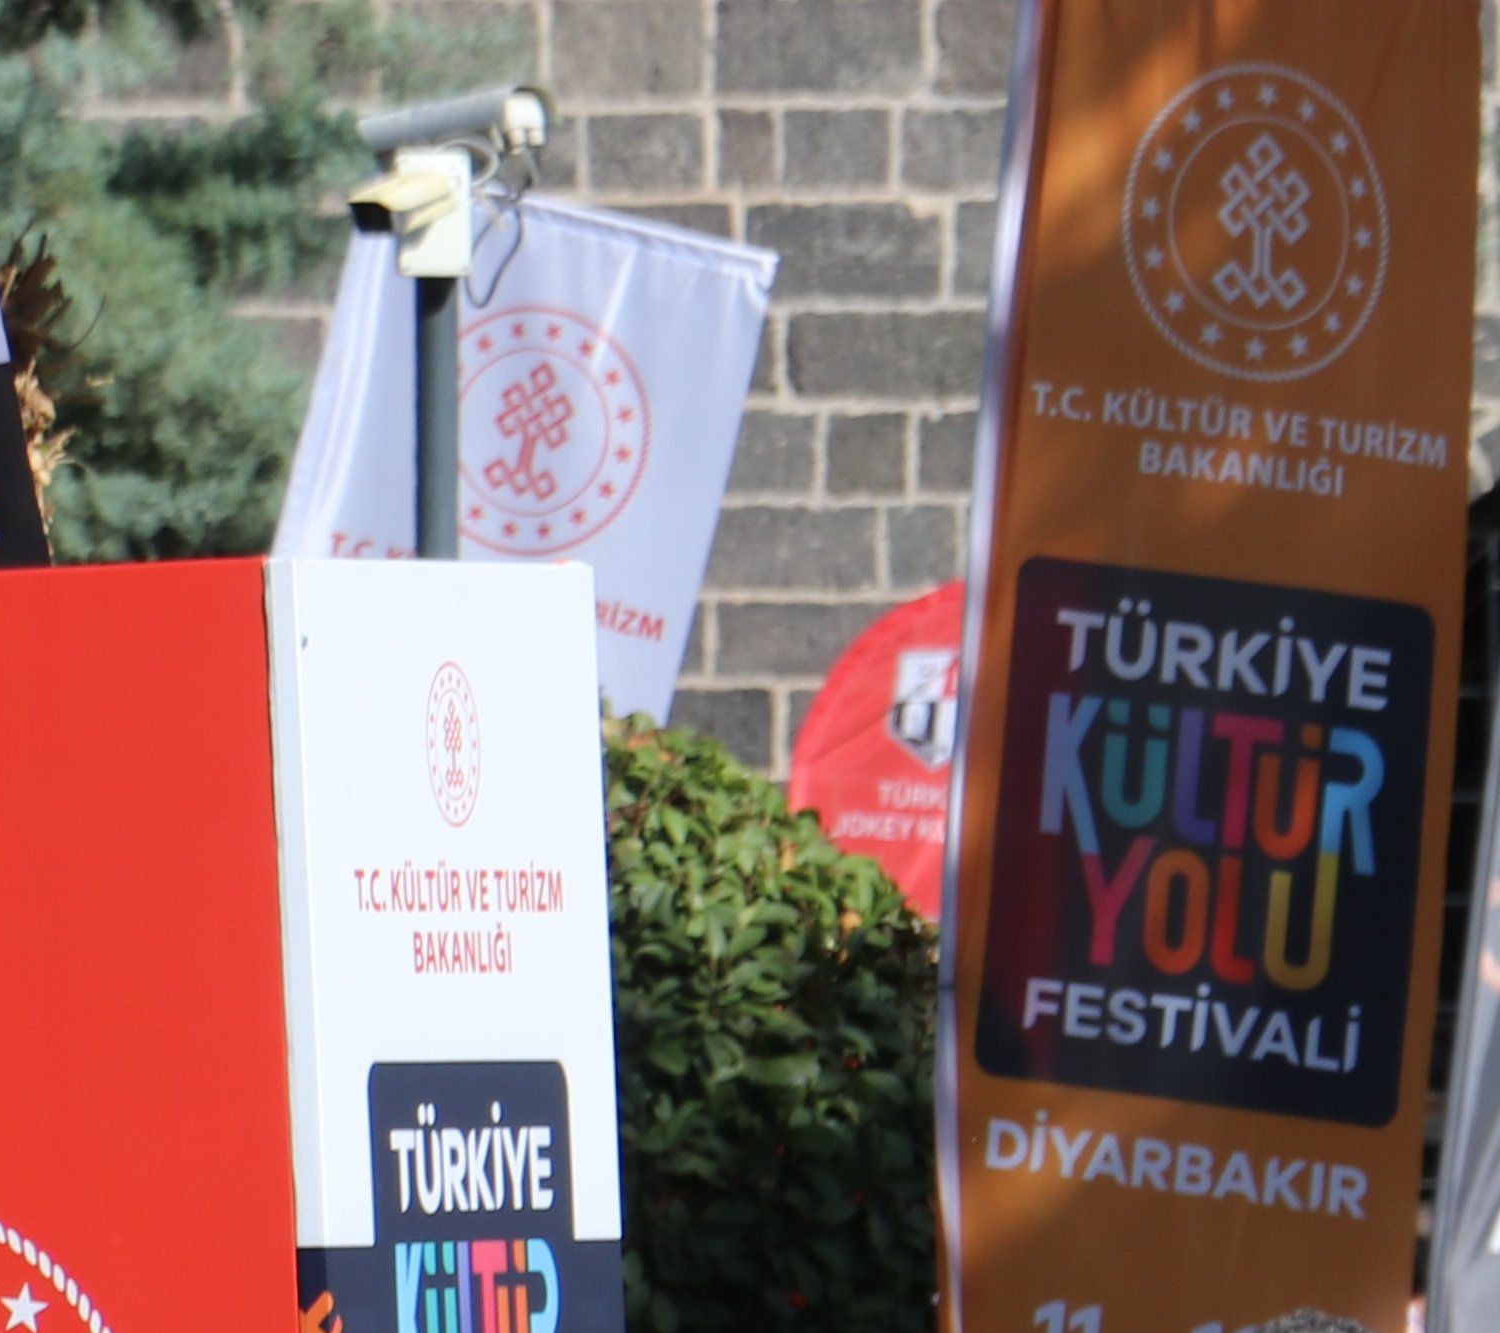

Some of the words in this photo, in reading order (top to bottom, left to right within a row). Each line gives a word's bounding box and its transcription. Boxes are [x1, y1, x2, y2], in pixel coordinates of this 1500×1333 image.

[1030, 383, 1092, 422] T.C.
[1102, 387, 1252, 440] KÜLTÜR
[1263, 410, 1309, 447] VE
[1318, 416, 1448, 470] TURİZM
[1137, 441, 1345, 498] BAKANLIĞI
[1056, 597, 1392, 712] TÜRKİYE
[1039, 691, 1386, 878] KÜLTÜR
[353, 868, 387, 913] T.C.
[390, 861, 462, 913] KÜLTÜR
[465, 869, 490, 913] VE
[493, 861, 565, 913] TURİZM
[1080, 836, 1341, 992] YOLU
[412, 921, 514, 974] BAKANLIĞI
[1022, 978, 1363, 1074] FESTİVALİ
[389, 1100, 555, 1215] TÜRKİYE
[984, 1108, 1369, 1220] DİYARBAKIR
